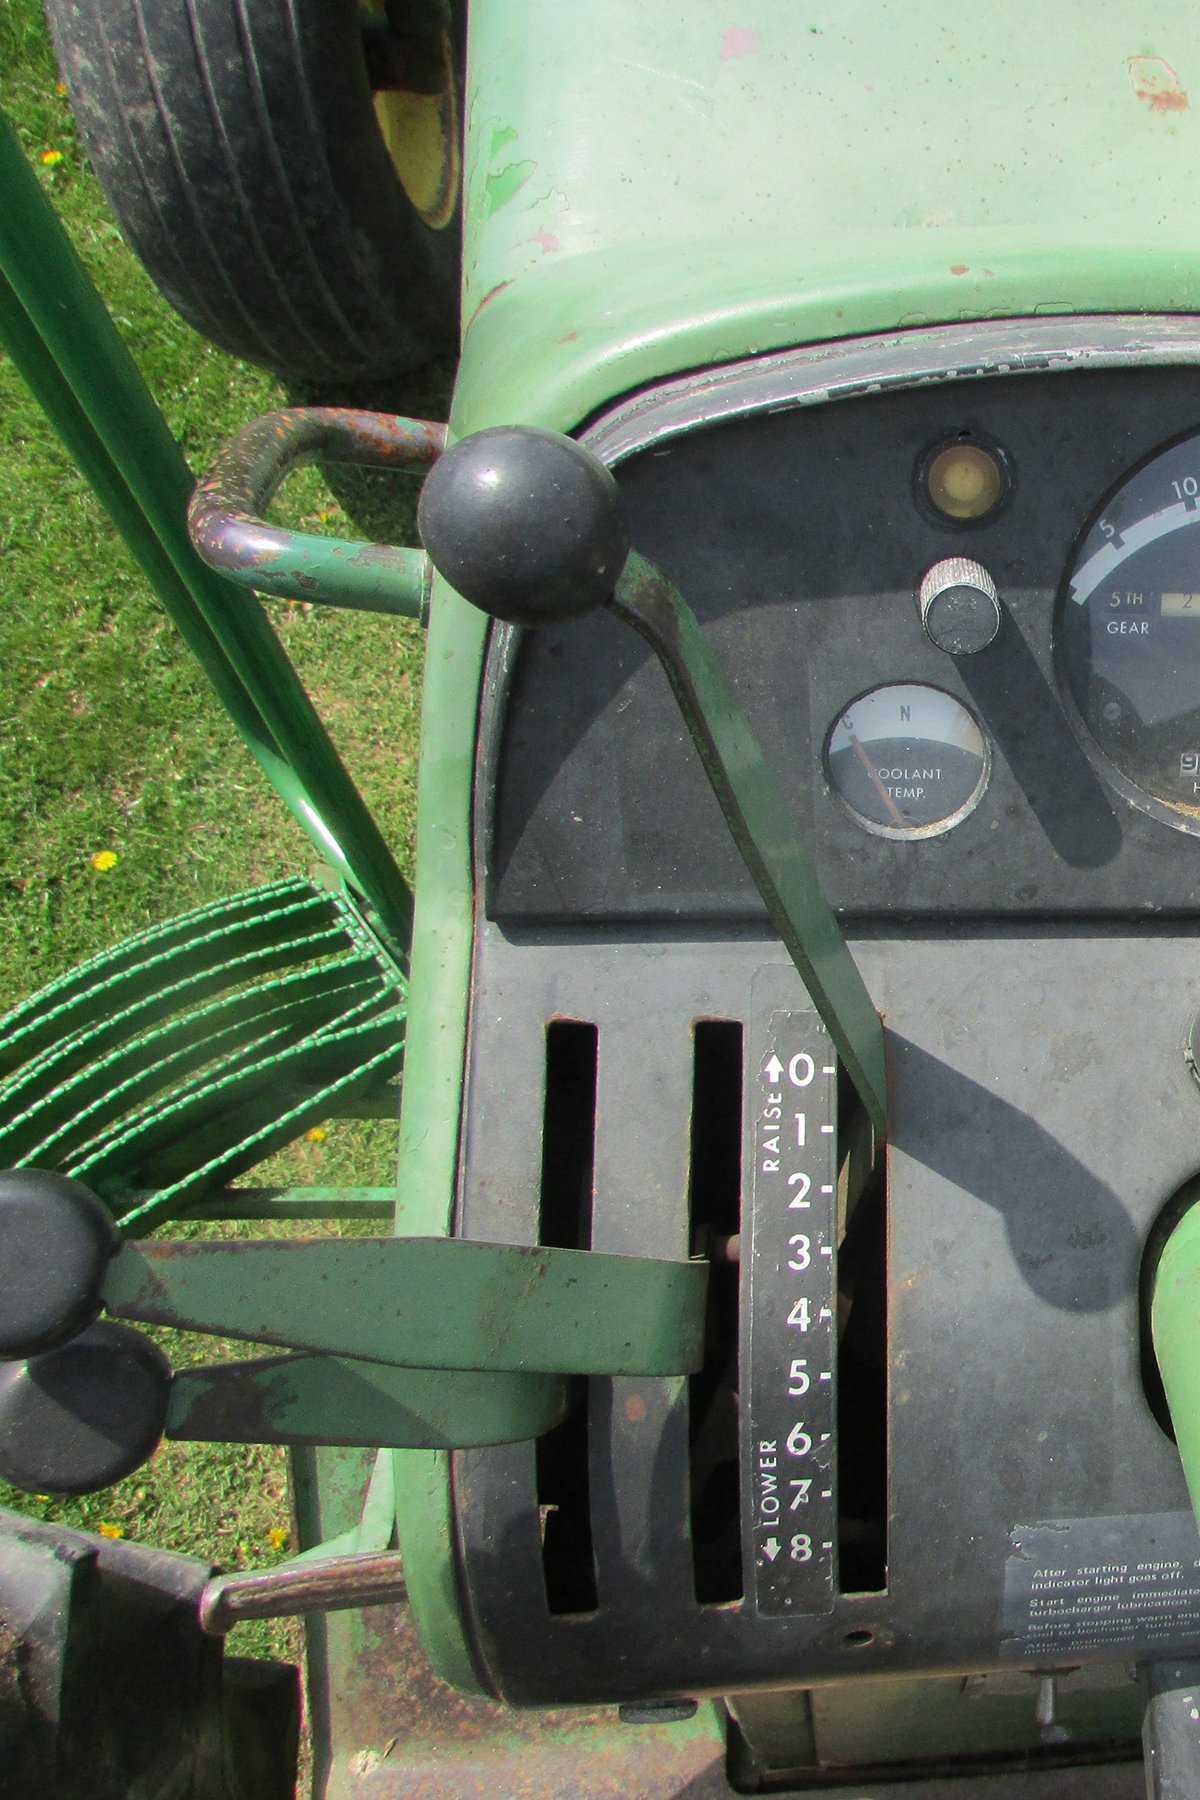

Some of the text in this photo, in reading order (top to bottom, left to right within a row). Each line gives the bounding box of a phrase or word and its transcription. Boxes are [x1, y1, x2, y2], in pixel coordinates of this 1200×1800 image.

[1171, 476, 1198, 499] 10
[1099, 519, 1115, 539] 5
[1182, 593, 1192, 609] 2
[1106, 621, 1149, 634] GEAR
[900, 705, 911, 721] N
[875, 768, 942, 780] OOLANT
[887, 786, 926, 799] TEMP.
[788, 1053, 815, 1086] 0
[763, 1092, 783, 1172] RAISE
[794, 1113, 806, 1146] 1
[788, 1173, 812, 1209] 2
[788, 1234, 811, 1271] 3
[786, 1297, 811, 1332] 4
[788, 1359, 811, 1395] 5
[786, 1421, 812, 1456] 6
[760, 1439, 780, 1526] LOWER
[789, 1479, 813, 1511] 7
[790, 1533, 813, 1561] 8
[1031, 1571, 1184, 1590] indicator light goes off.
[1033, 1568, 1067, 1578] After
[1077, 1563, 1128, 1575] starting
[1029, 1598, 1064, 1608] Start
[1077, 1594, 1120, 1604] engine
[1029, 1599, 1191, 1617] turbocharger lubrication.
